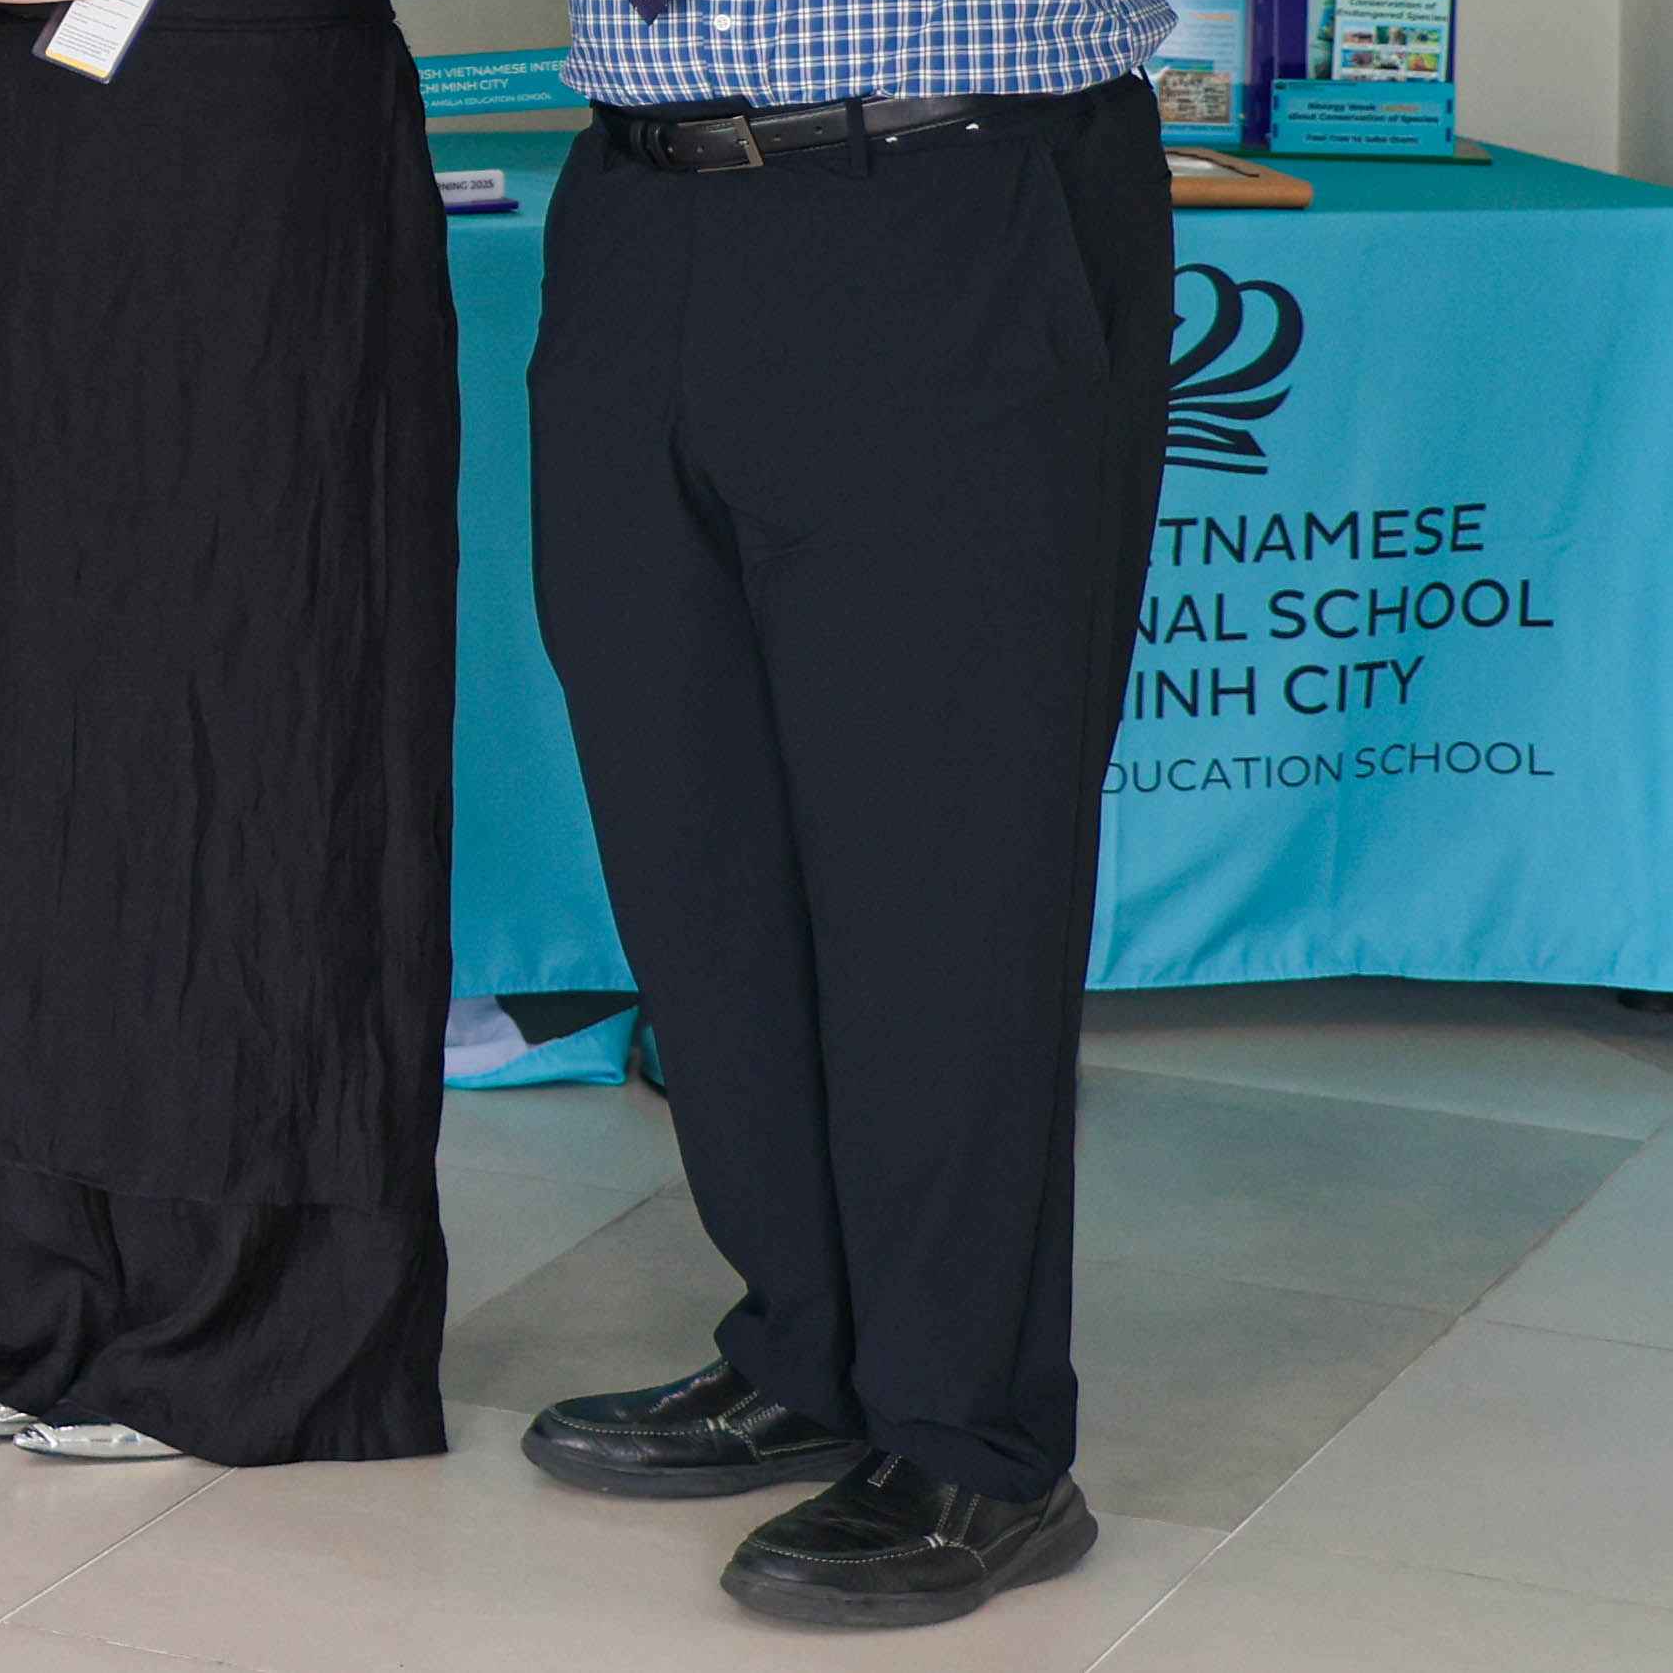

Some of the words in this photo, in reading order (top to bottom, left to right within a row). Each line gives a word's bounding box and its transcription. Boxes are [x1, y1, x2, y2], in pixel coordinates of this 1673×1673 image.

[442, 81, 477, 93] MINH
[480, 78, 510, 91] CITY
[445, 63, 528, 78] VIETNAMESE
[471, 179, 495, 190] 2025
[1157, 503, 1487, 567] TNAMESE
[1268, 579, 1555, 640] SCHOOL
[1136, 666, 1255, 721] INH
[1284, 656, 1424, 714] CITY
[1102, 751, 1343, 794] DUCATION
[1354, 741, 1555, 779] SCHOOL
